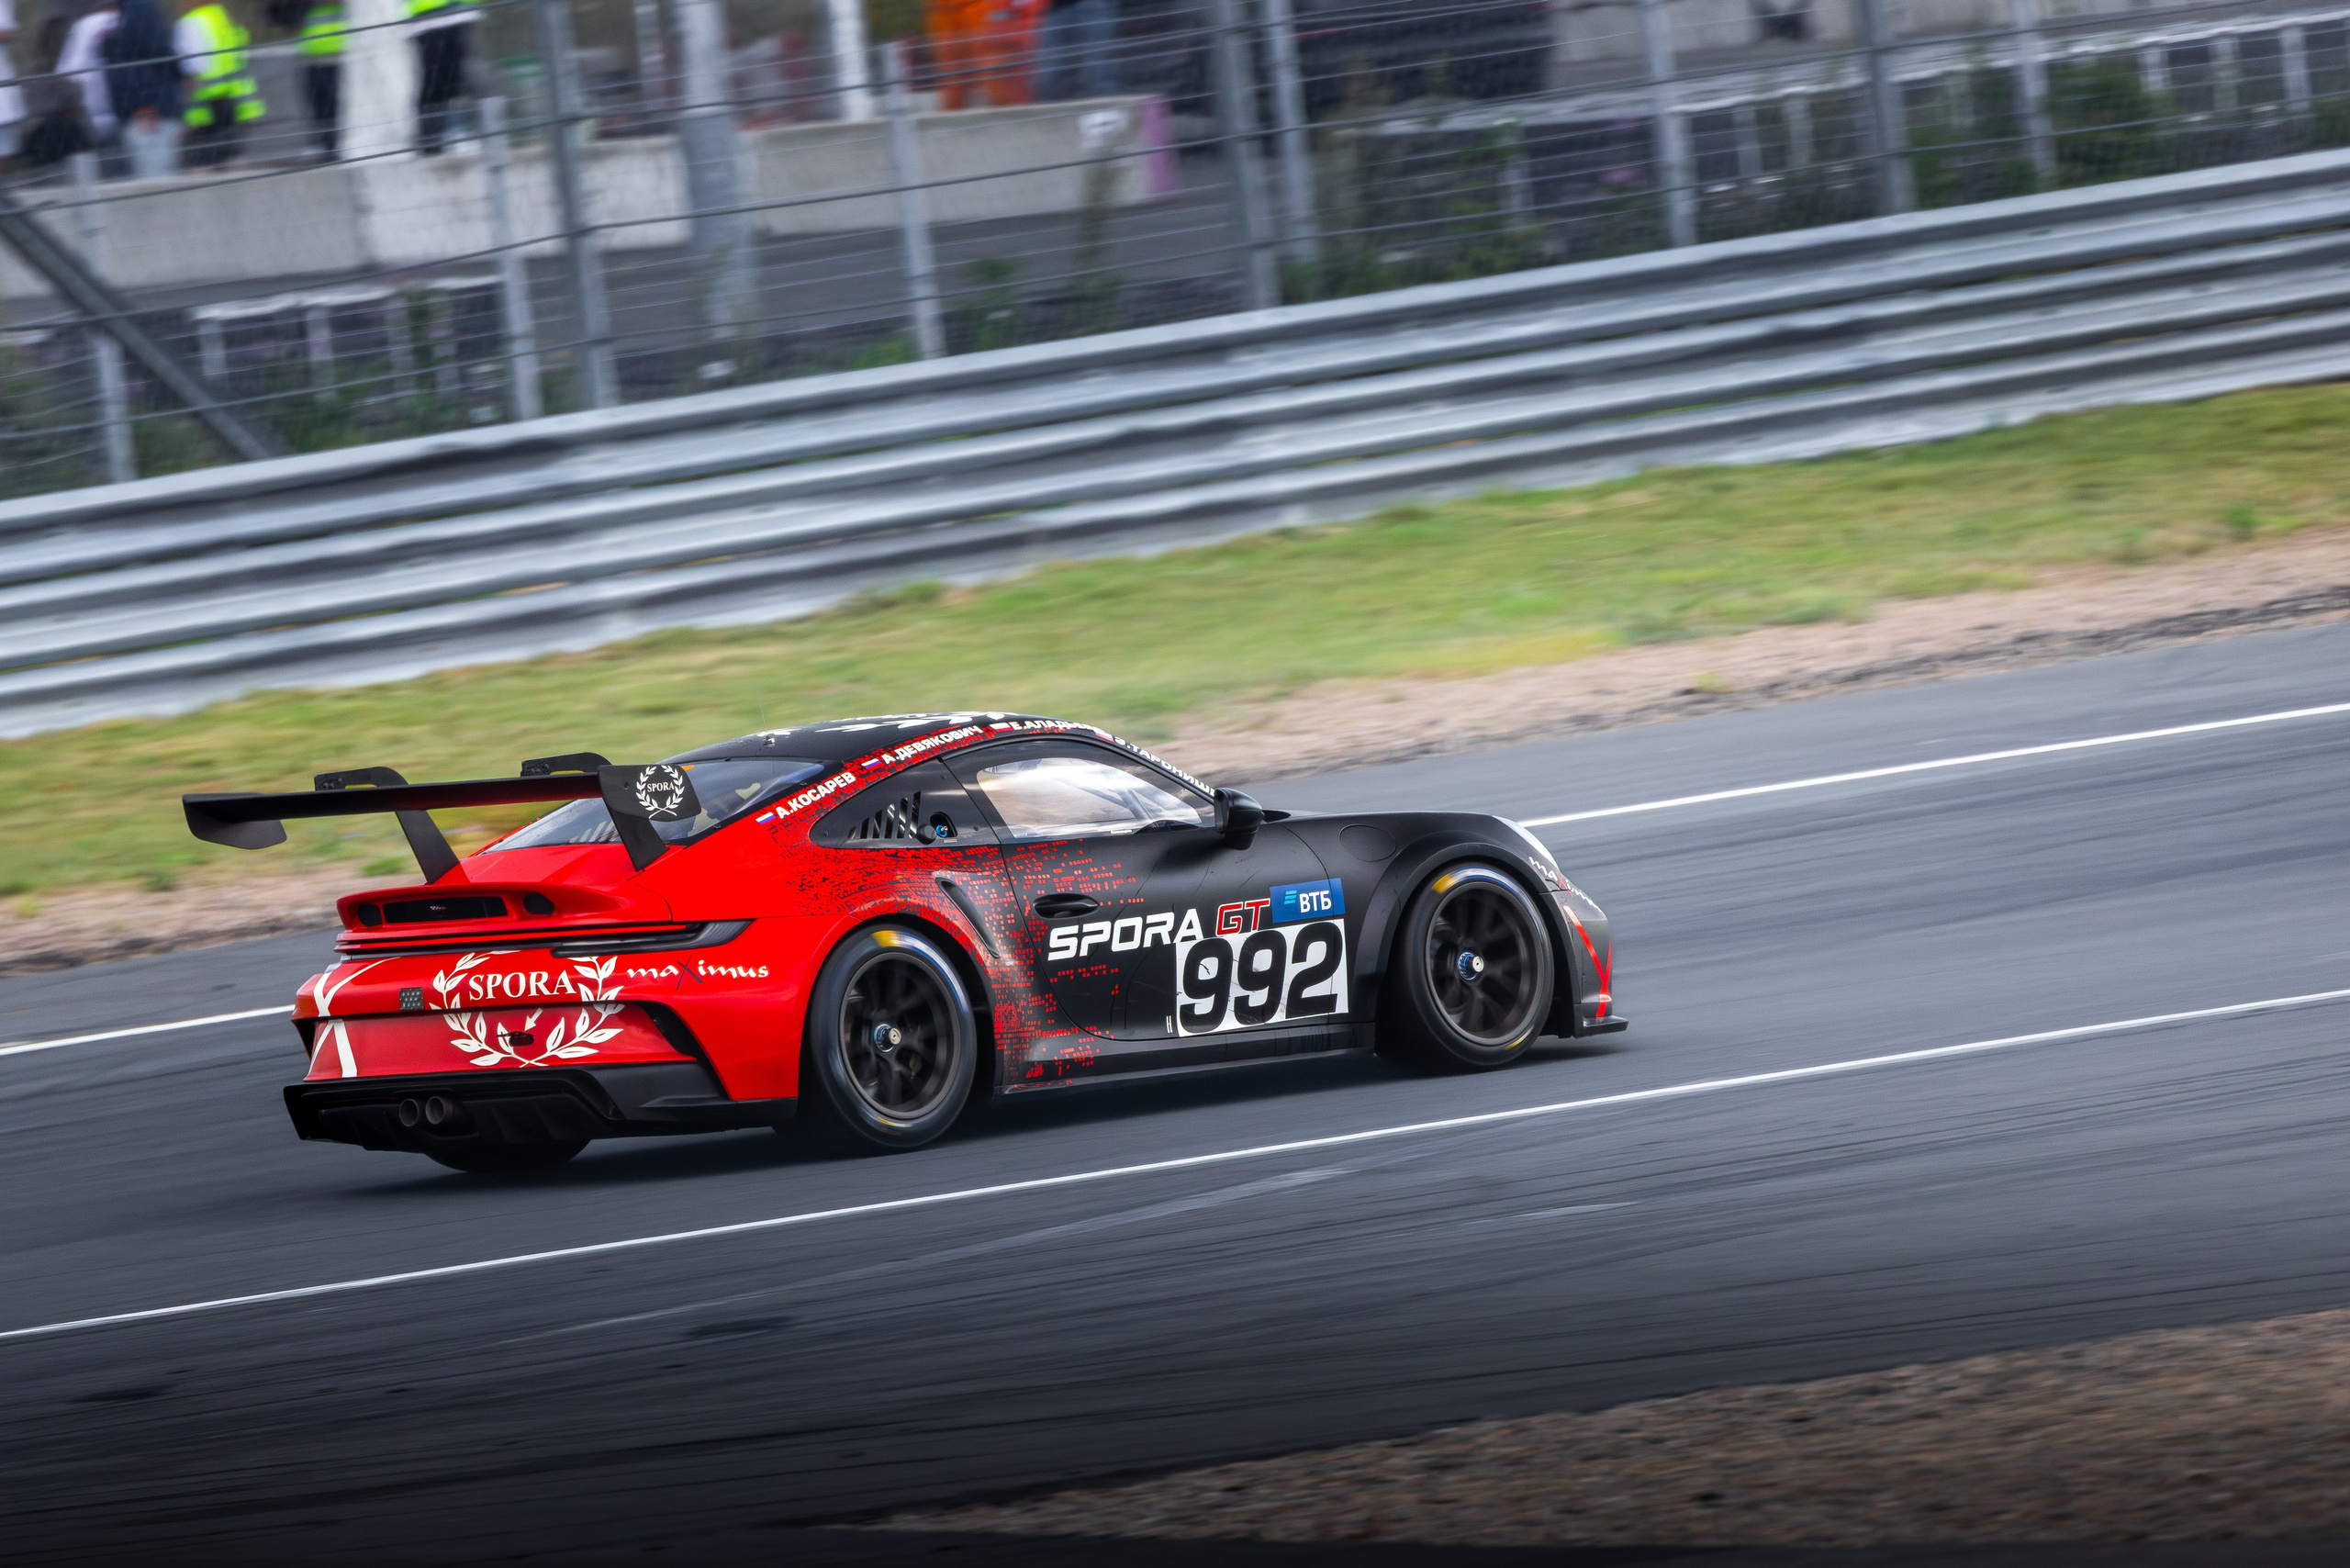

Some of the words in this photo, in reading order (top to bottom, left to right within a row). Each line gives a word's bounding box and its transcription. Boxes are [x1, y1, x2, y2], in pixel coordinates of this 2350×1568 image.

[881, 725, 983, 765] А.ДЕВЯКОВИЧ
[646, 781, 675, 793] SPORA
[776, 771, 856, 819] А.КОСАРЕВ
[1299, 890, 1332, 913] ВТБ
[1047, 908, 1204, 961] SPORA
[1215, 898, 1271, 936] GT
[469, 970, 576, 1002] SPORA
[1180, 922, 1343, 1034] 992
